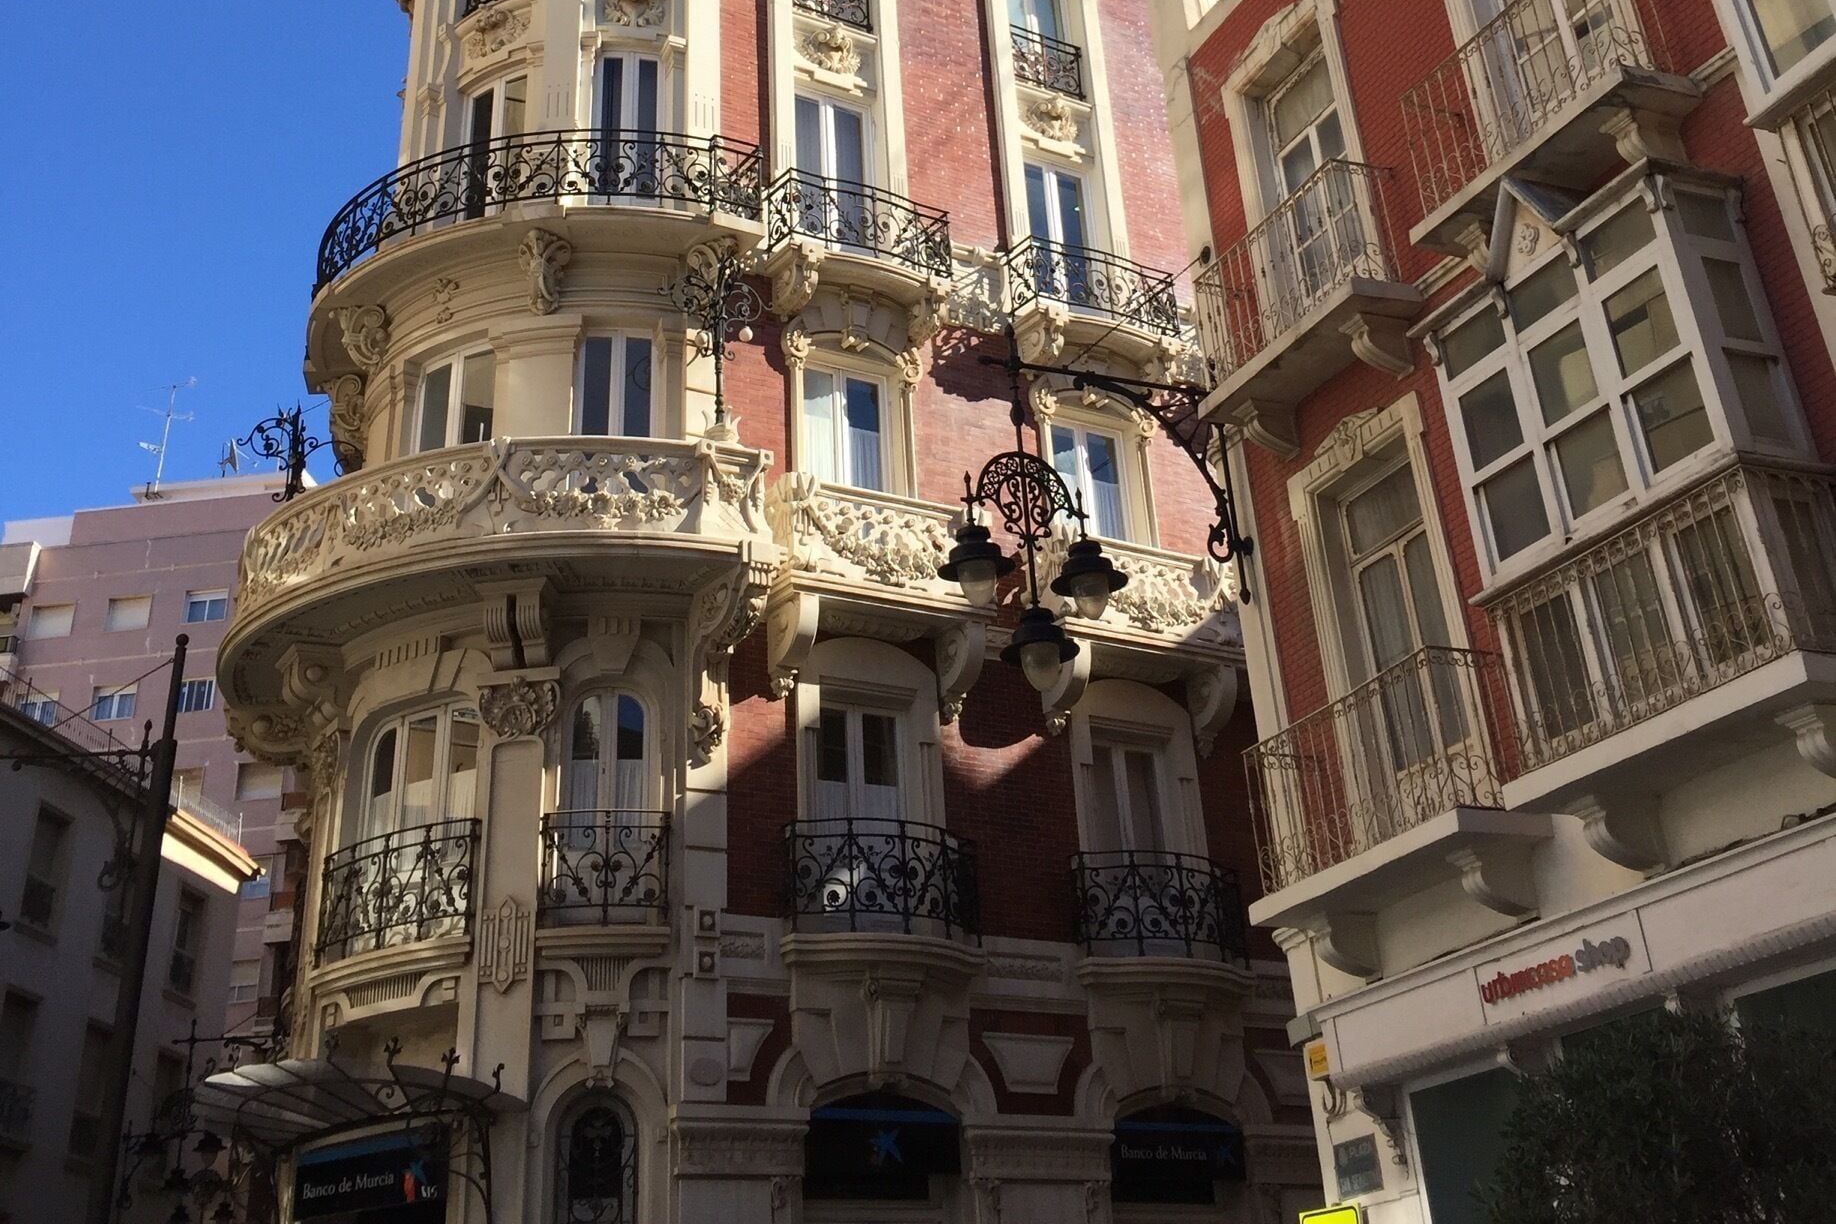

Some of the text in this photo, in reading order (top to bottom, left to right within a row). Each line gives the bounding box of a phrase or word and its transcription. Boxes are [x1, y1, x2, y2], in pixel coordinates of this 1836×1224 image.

[1575, 936, 1631, 972] shop
[1120, 1144, 1207, 1161] Banco de Murcia
[303, 1172, 394, 1200] Banco de Murcia
